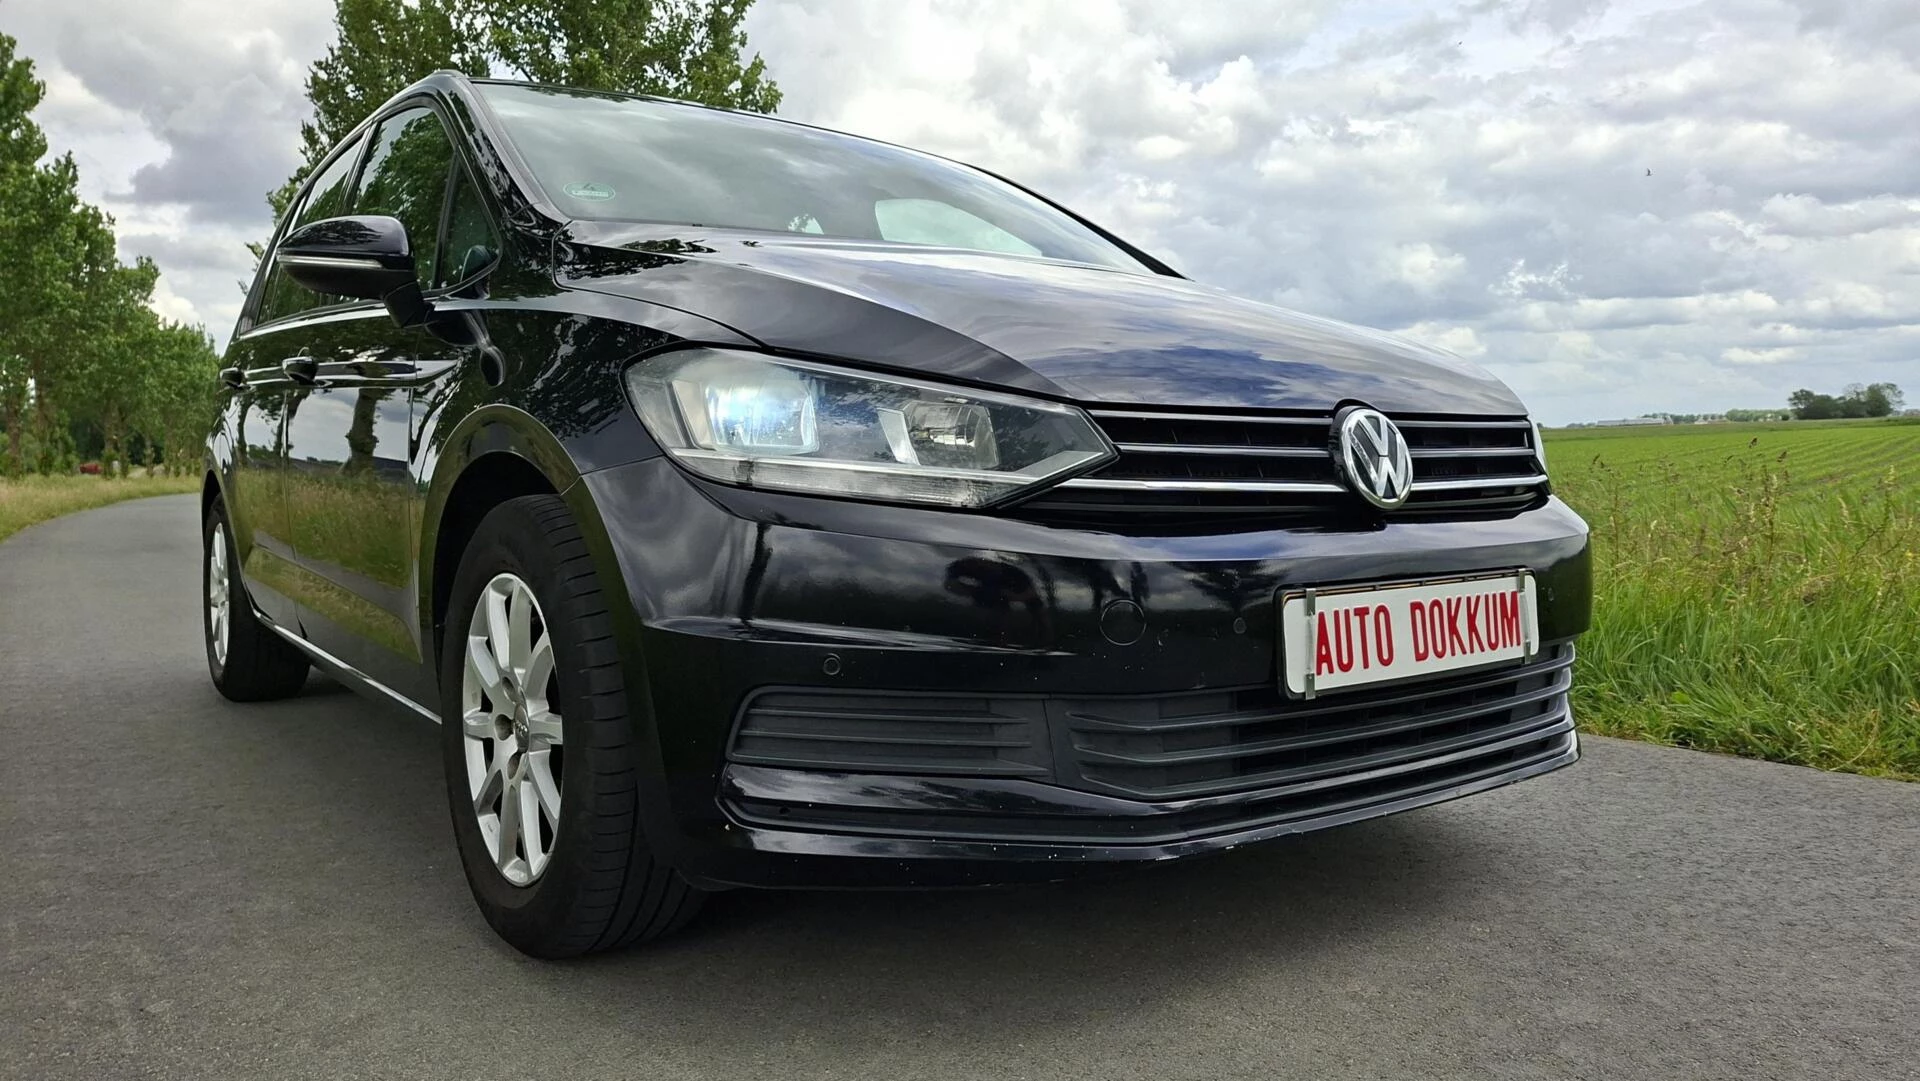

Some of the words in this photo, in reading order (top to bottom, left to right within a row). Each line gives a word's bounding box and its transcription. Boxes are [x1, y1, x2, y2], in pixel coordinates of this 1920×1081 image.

[1344, 410, 1412, 505] VW
[1316, 604, 1394, 676] AUTO
[1409, 591, 1521, 662] DOKKUM
